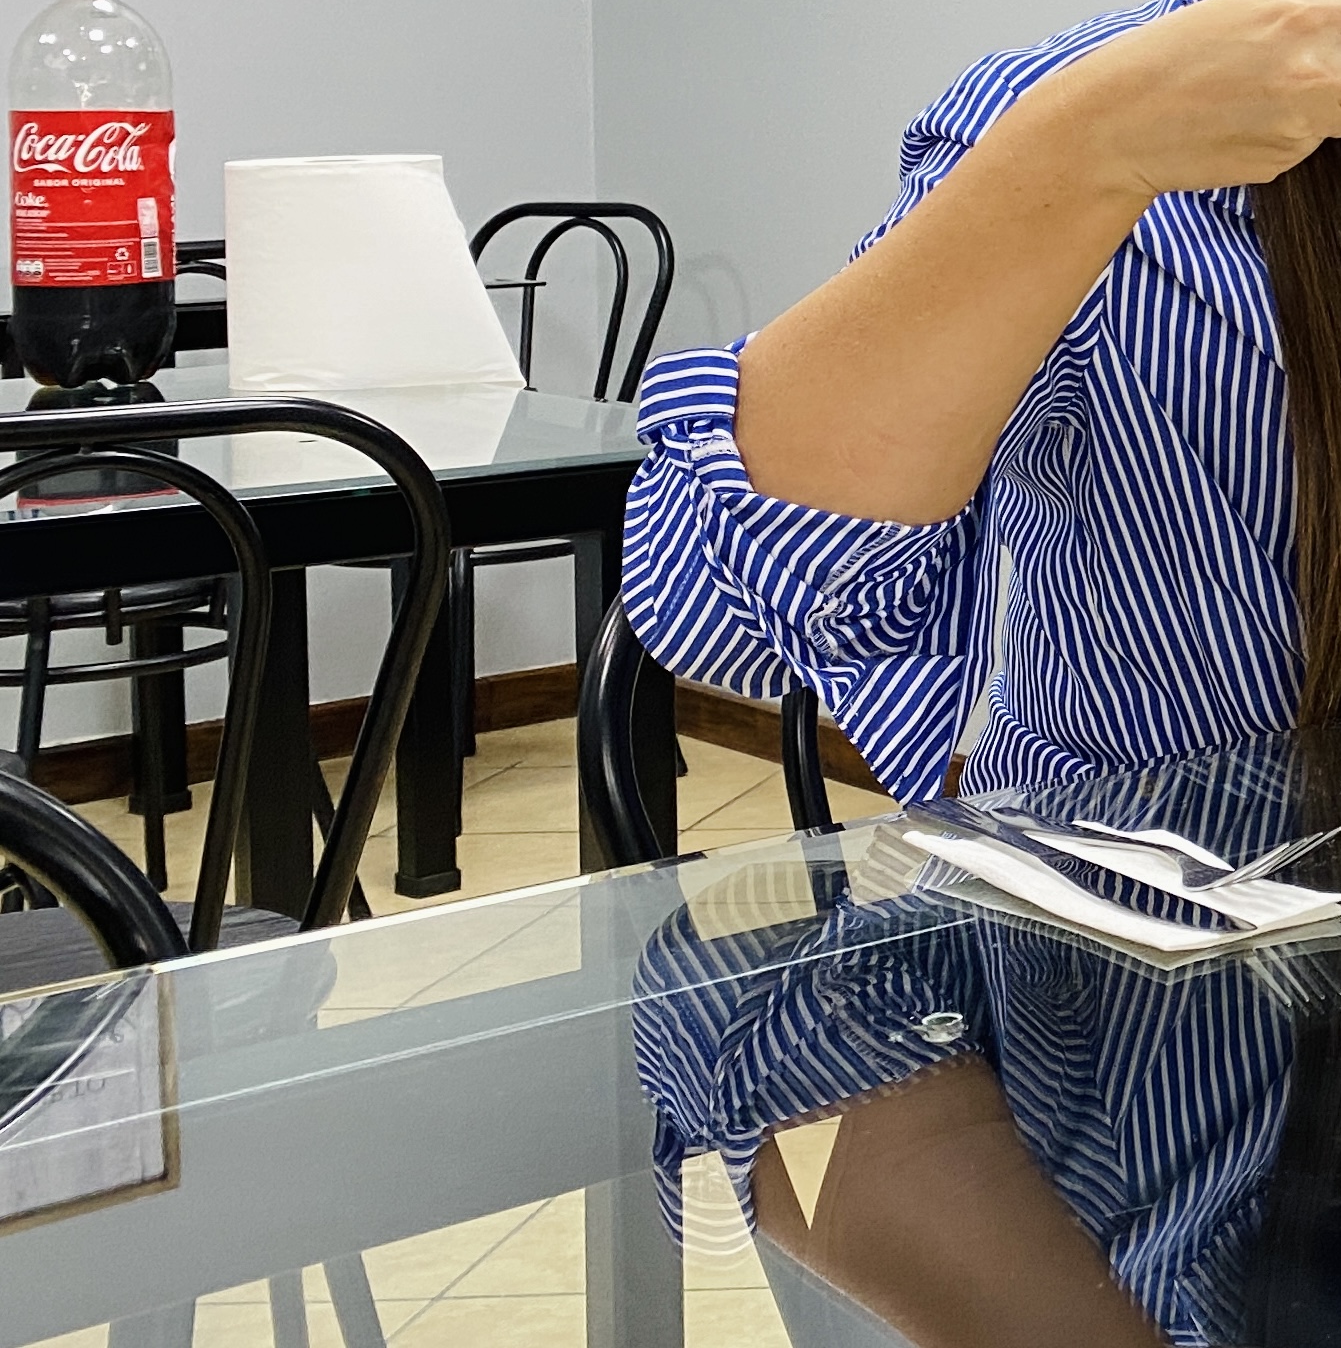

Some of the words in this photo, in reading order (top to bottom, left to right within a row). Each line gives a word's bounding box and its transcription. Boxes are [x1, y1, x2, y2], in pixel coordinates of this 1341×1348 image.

[14, 122, 152, 173] Coca-Cola
[33, 178, 69, 187] SABOR
[71, 177, 126, 187] ORIGINAL
